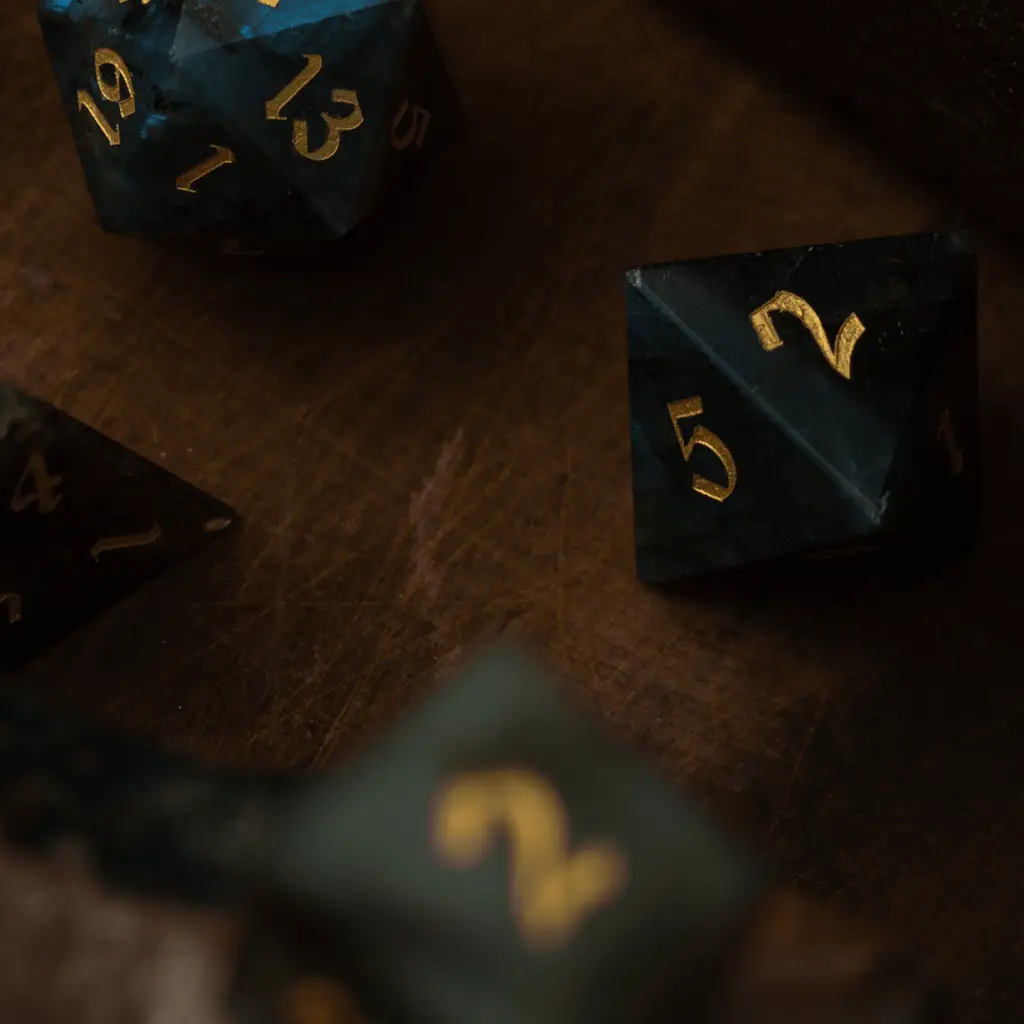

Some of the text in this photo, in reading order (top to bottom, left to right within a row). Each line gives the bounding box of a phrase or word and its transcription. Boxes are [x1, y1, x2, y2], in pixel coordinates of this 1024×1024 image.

[77, 47, 136, 146] 19
[265, 53, 364, 162] 13
[176, 143, 237, 193] 1
[749, 289, 866, 380] 2
[666, 394, 737, 503] 5
[90, 518, 163, 565] 1
[432, 766, 629, 954] 2
